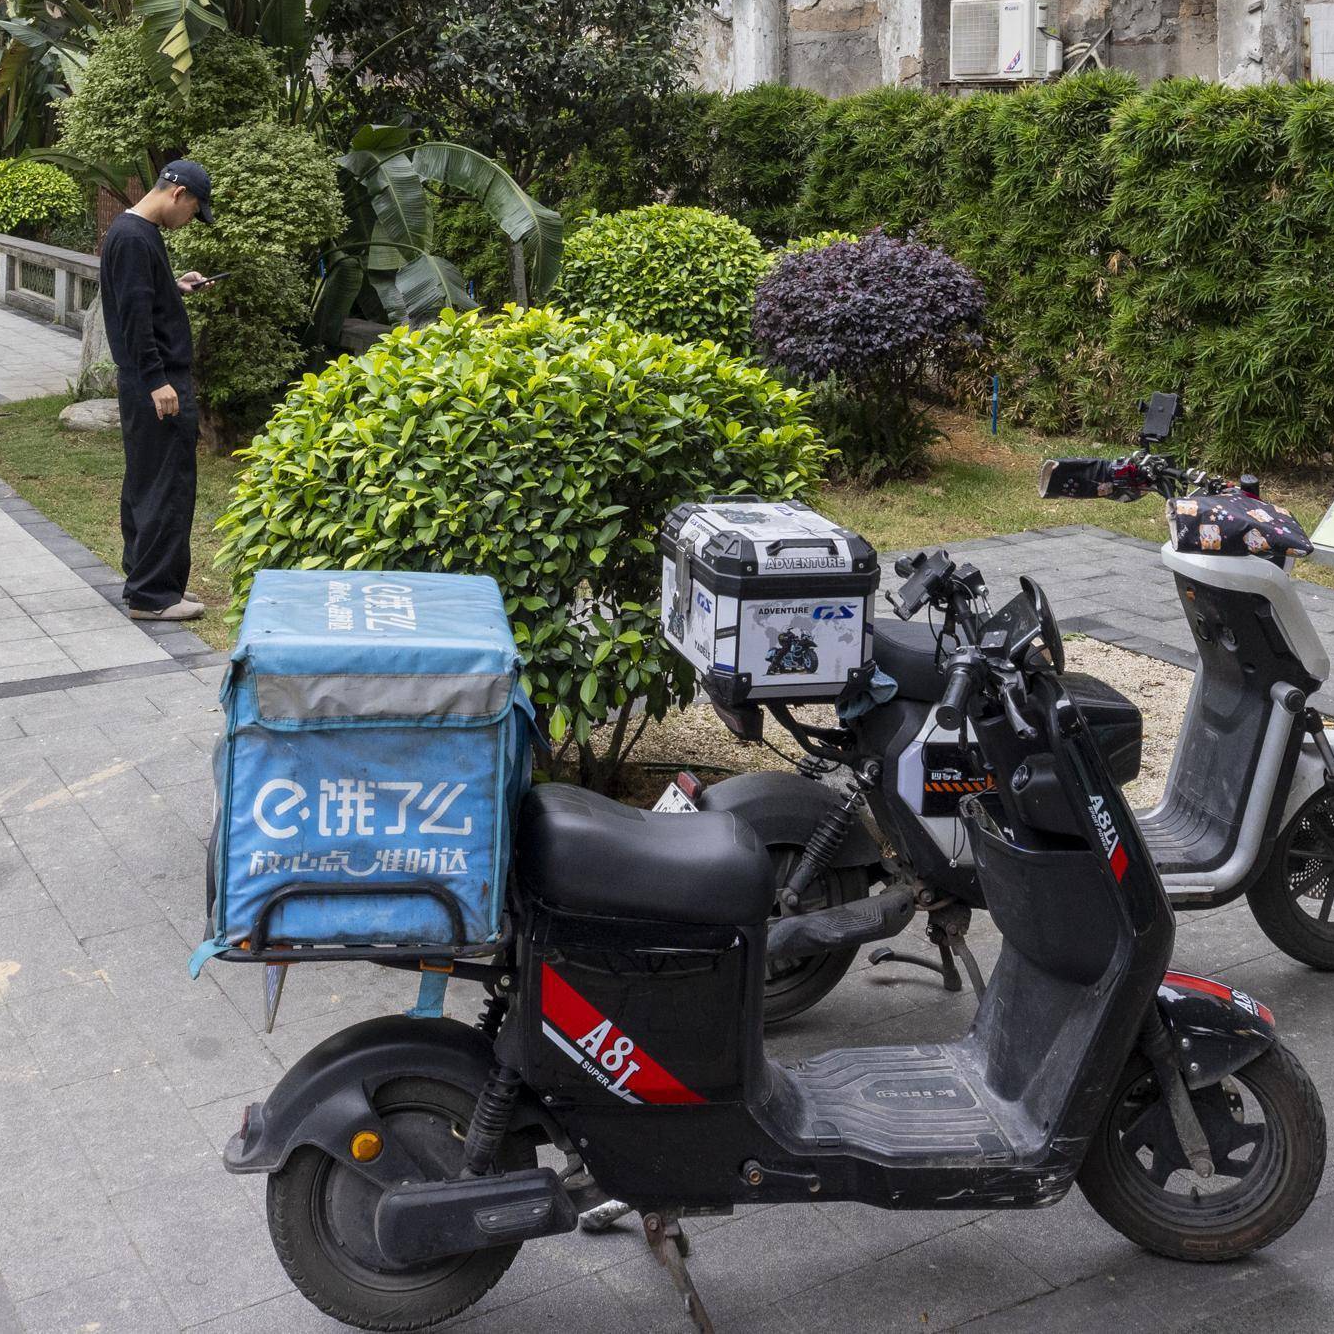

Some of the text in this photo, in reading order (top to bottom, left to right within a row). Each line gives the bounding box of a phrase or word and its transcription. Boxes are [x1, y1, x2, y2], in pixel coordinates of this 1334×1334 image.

[766, 556, 846, 570] ADVENTURE
[758, 604, 859, 620] ADVENTURE GS
[576, 1018, 641, 1098] A8L
[581, 1060, 610, 1087] SUPER
